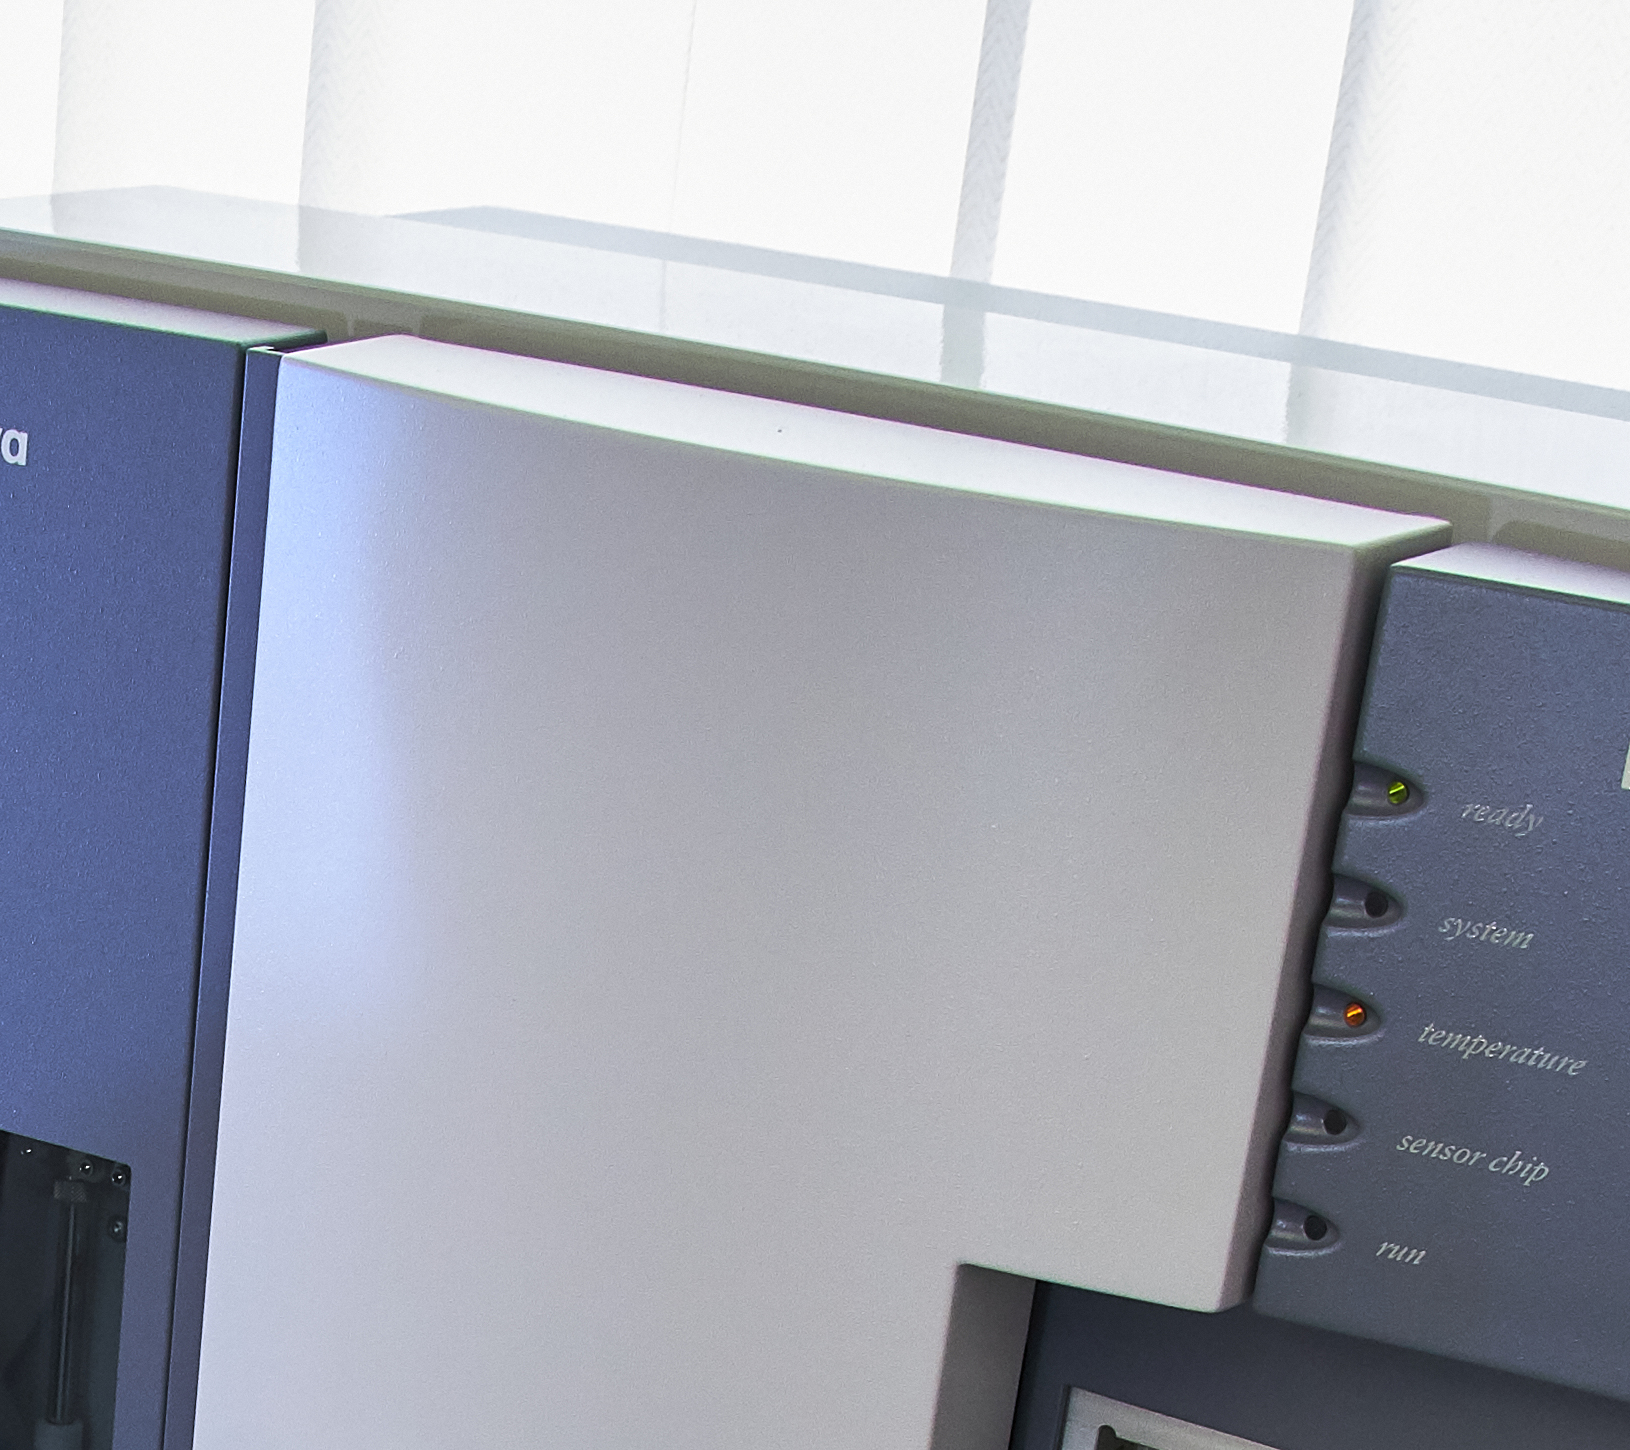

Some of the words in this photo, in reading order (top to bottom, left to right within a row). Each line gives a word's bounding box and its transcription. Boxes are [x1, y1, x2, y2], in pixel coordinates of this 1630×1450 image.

[1461, 803, 1543, 837] ready
[1439, 917, 1535, 950] system
[1418, 1023, 1586, 1076] temperature
[1396, 1134, 1486, 1166] sensor
[1488, 1151, 1549, 1186] chip
[1376, 1241, 1427, 1264] run
